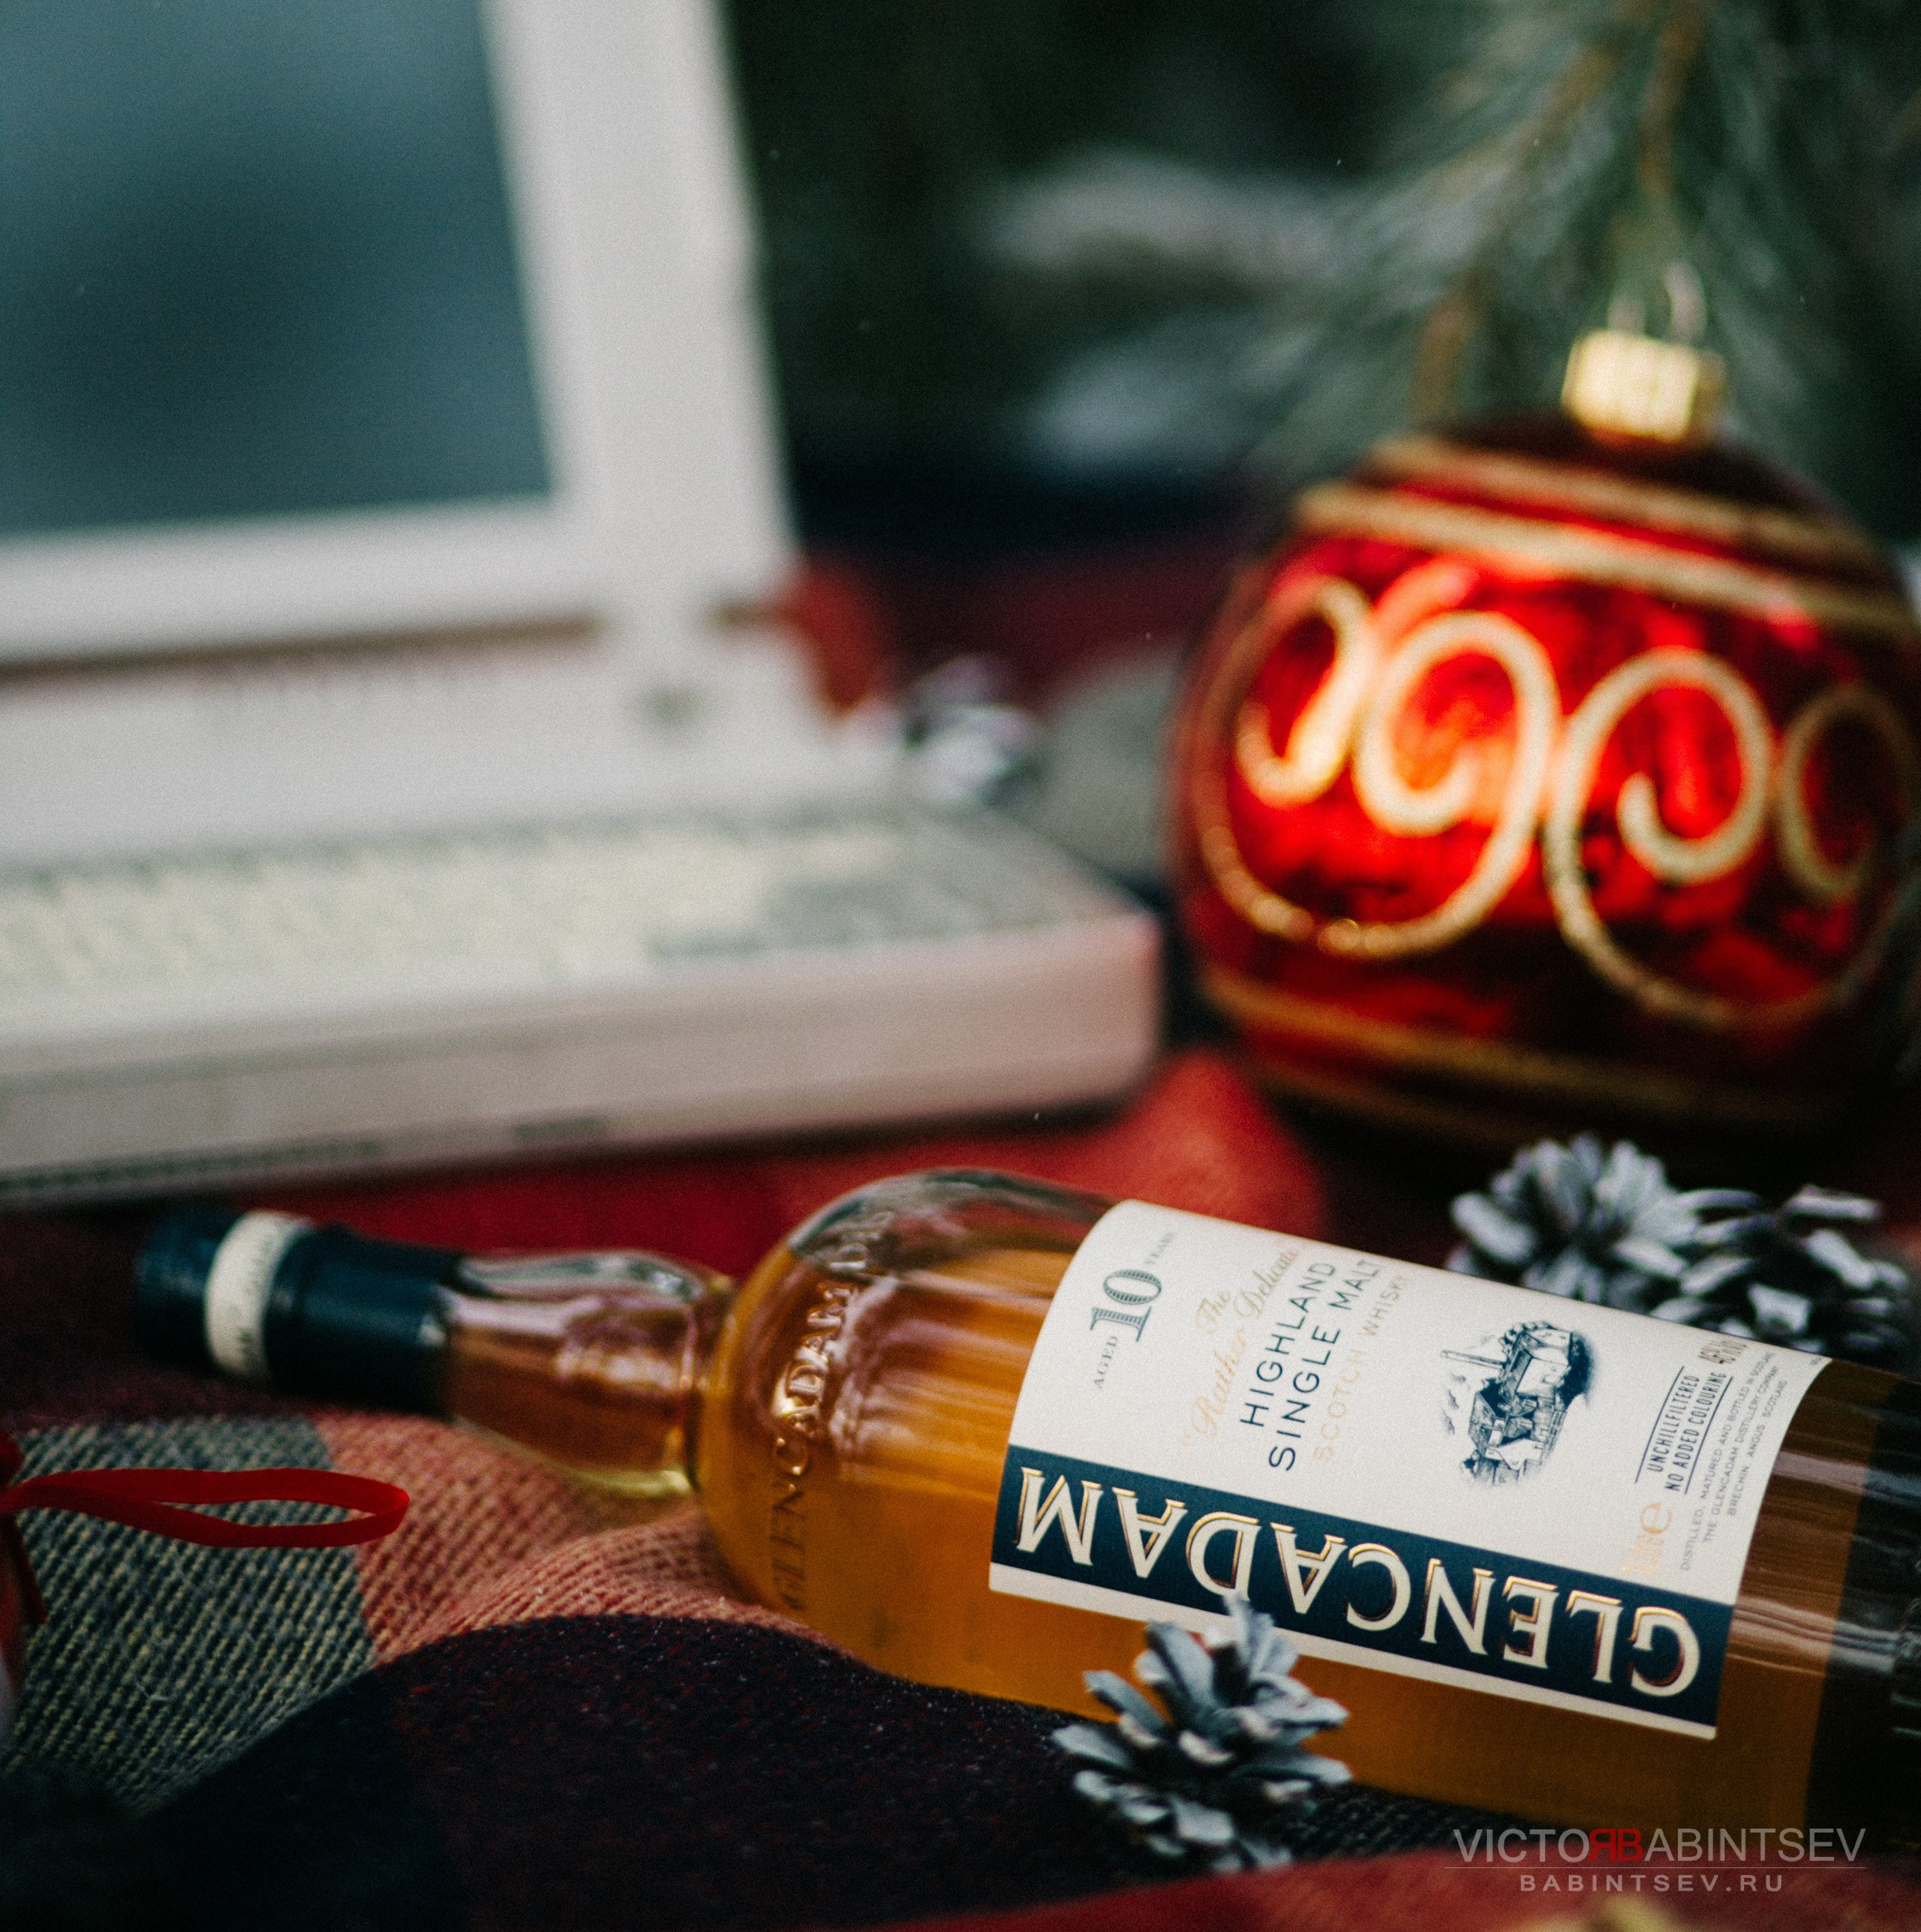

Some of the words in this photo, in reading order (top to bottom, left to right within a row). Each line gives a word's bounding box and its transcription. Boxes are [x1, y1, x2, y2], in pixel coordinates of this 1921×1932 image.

[1090, 1269, 1162, 1342] 10
[1195, 1291, 1231, 1335] The
[1240, 1262, 1336, 1428] HIGHLAND
[1093, 1335, 1118, 1388] AGED
[1268, 1325, 1341, 1471] SINGLE
[1327, 1259, 1381, 1311] MALT
[1313, 1348, 1366, 1463] SCOTCH
[1357, 1275, 1408, 1336] WHISKY
[1688, 1371, 1727, 1425] COLOURING
[1646, 1375, 1700, 1473] UNCHILLFILTERED
[1672, 1429, 1700, 1468] ADDED
[1699, 1447, 1723, 1500] MATURED
[1719, 1424, 1733, 1445] AND
[1727, 1386, 1750, 1421] BOTTLED
[1703, 1520, 1717, 1542] THE
[1712, 1447, 1739, 1516] GLENCADAM
[1734, 1395, 1761, 1443] DISTILLERY
[1664, 1473, 1685, 1492] NO
[1013, 1466, 1702, 1697] GLENCADAM
